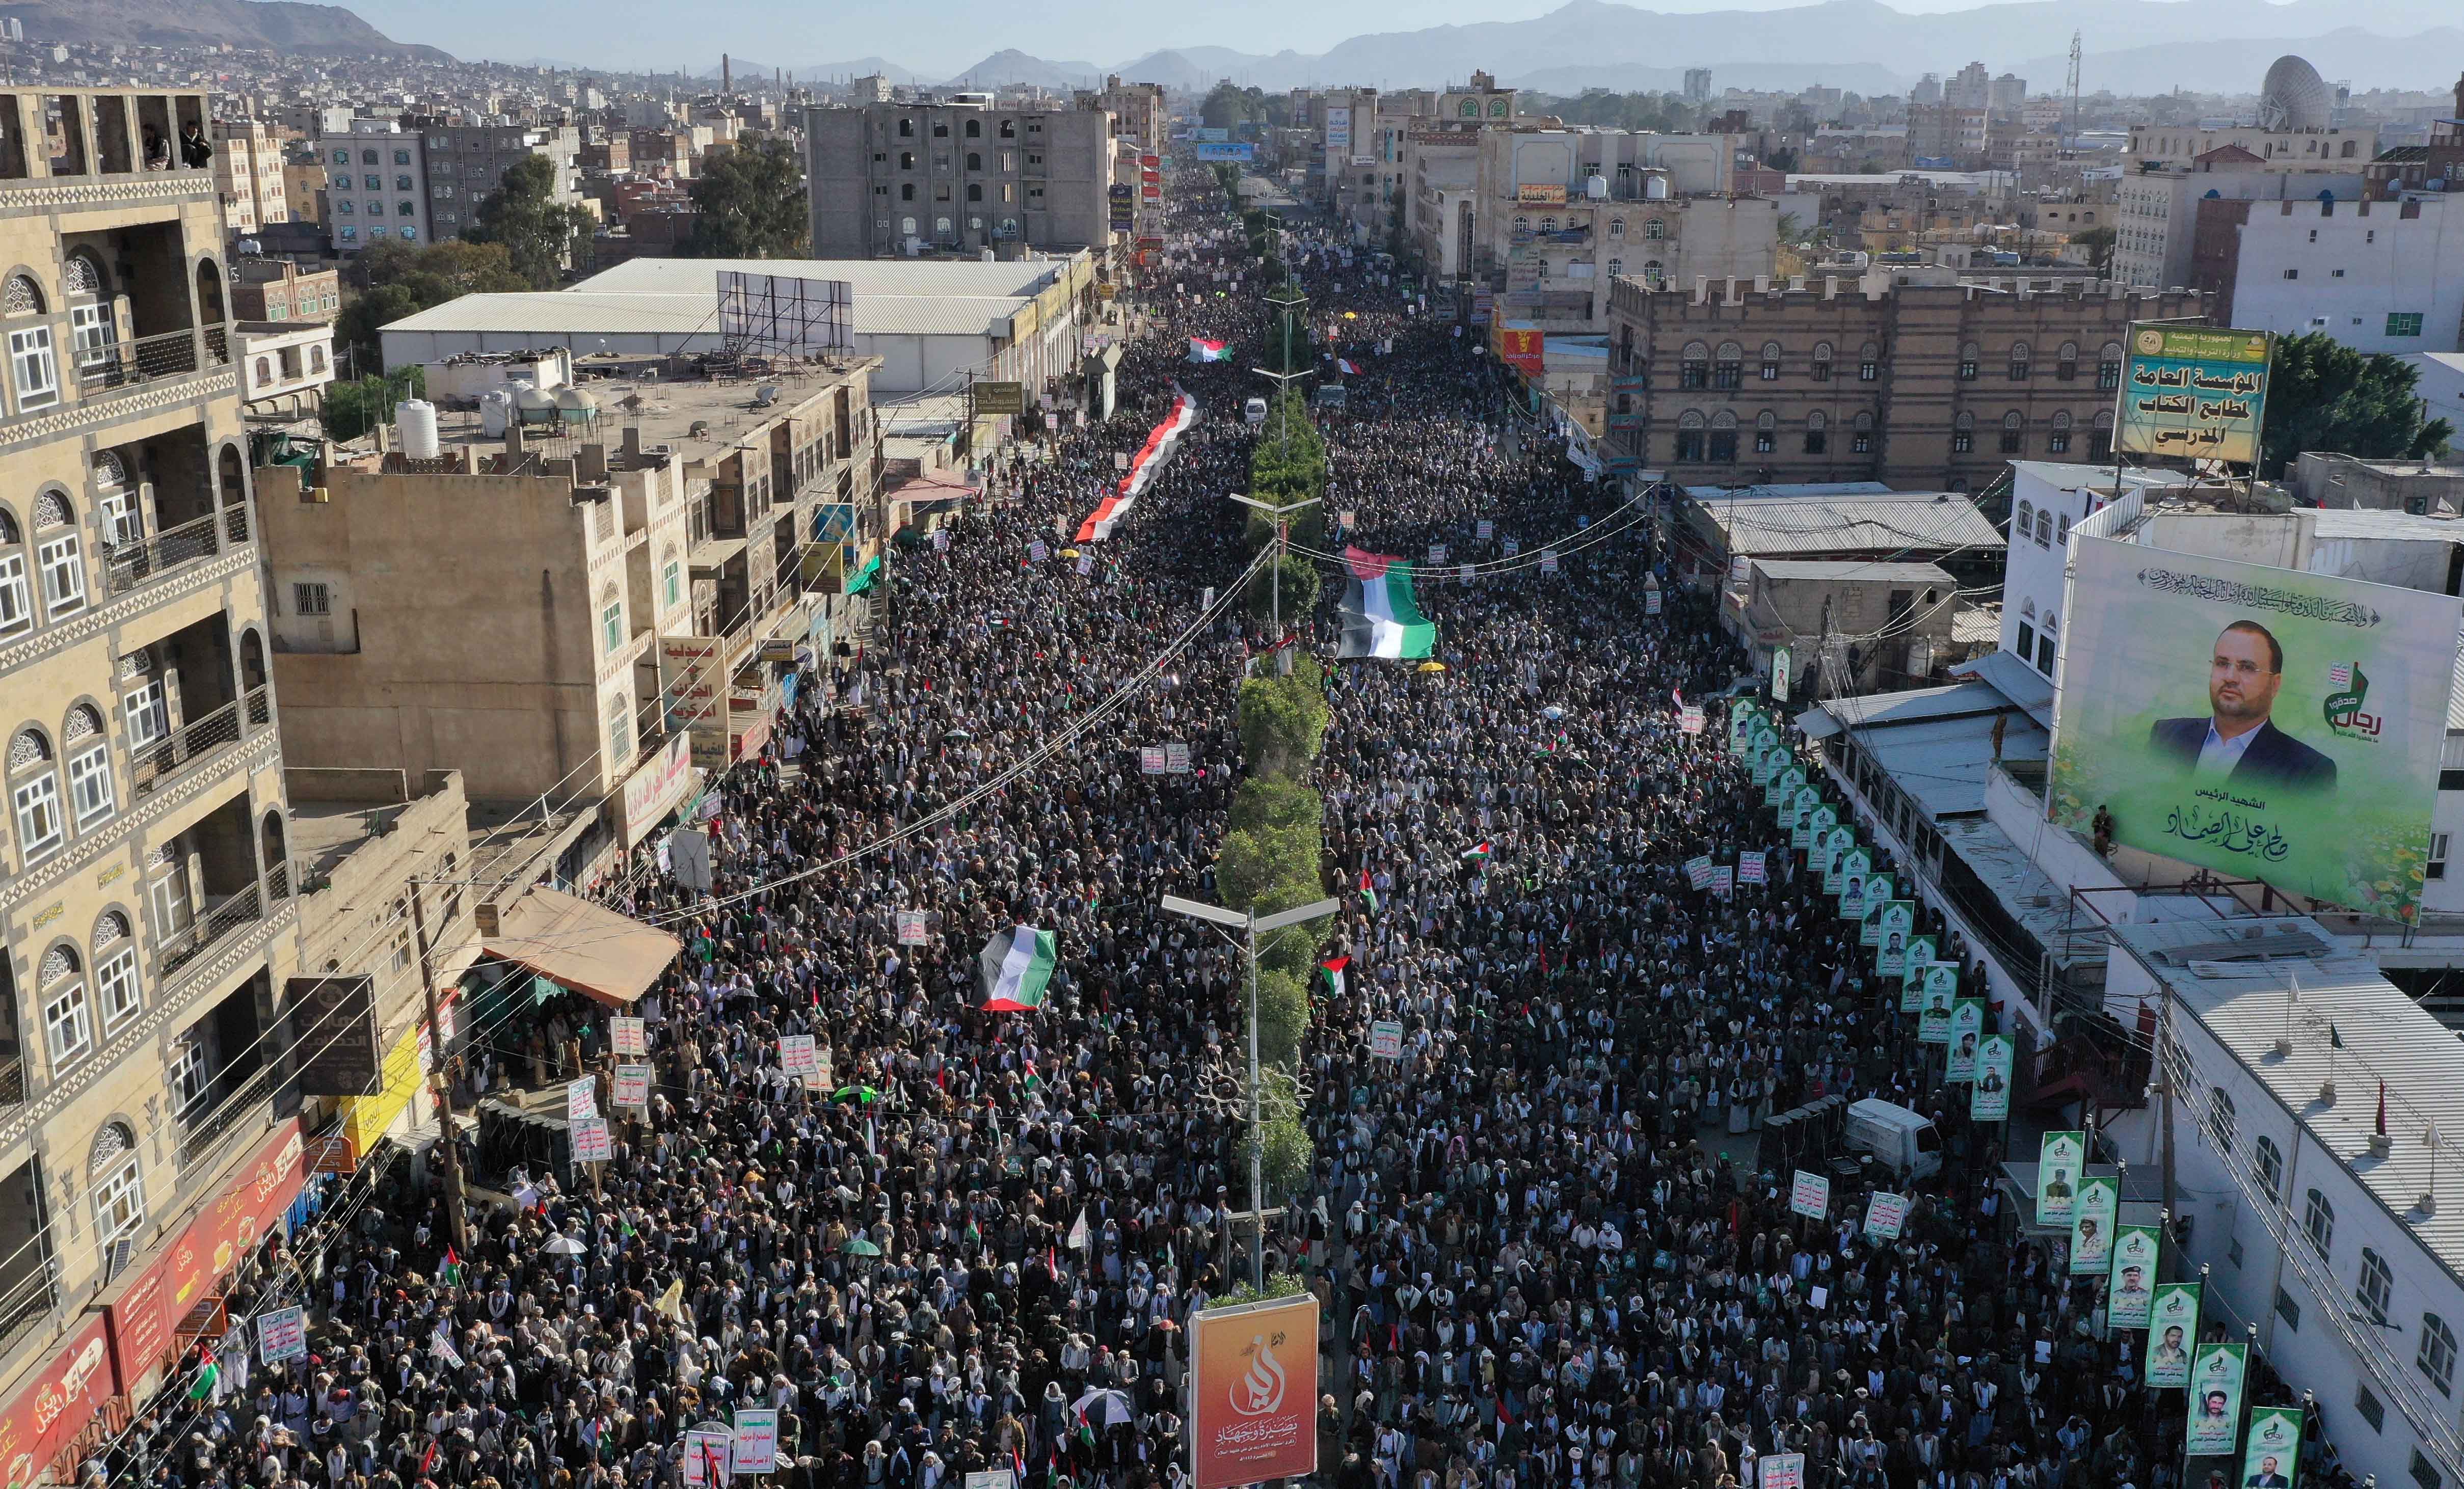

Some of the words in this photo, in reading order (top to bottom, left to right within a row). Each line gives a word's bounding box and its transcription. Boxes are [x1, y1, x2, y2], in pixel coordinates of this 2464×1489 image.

[2172, 332, 2197, 341] اليمنية
[2199, 333, 2234, 343] الجمهورية
[2194, 346, 2220, 356] التربية
[2221, 348, 2241, 358] وزارة
[2133, 364, 2190, 388] العامة
[2192, 368, 2263, 396] المؤسسة
[2138, 395, 2196, 415] الكتاب
[2199, 398, 2251, 420] لمطابع
[2155, 426, 2226, 447] المدرسي
[665, 643, 714, 659] صيدلية
[672, 683, 712, 700] الجراف
[2329, 697, 2357, 710] صدقوا
[2334, 711, 2381, 735] رجال
[2195, 789, 2229, 802] الرئيس
[2230, 797, 2265, 810] الشهيد
[2262, 824, 2288, 862] صالح
[741, 1417, 772, 1428] قاطعوا
